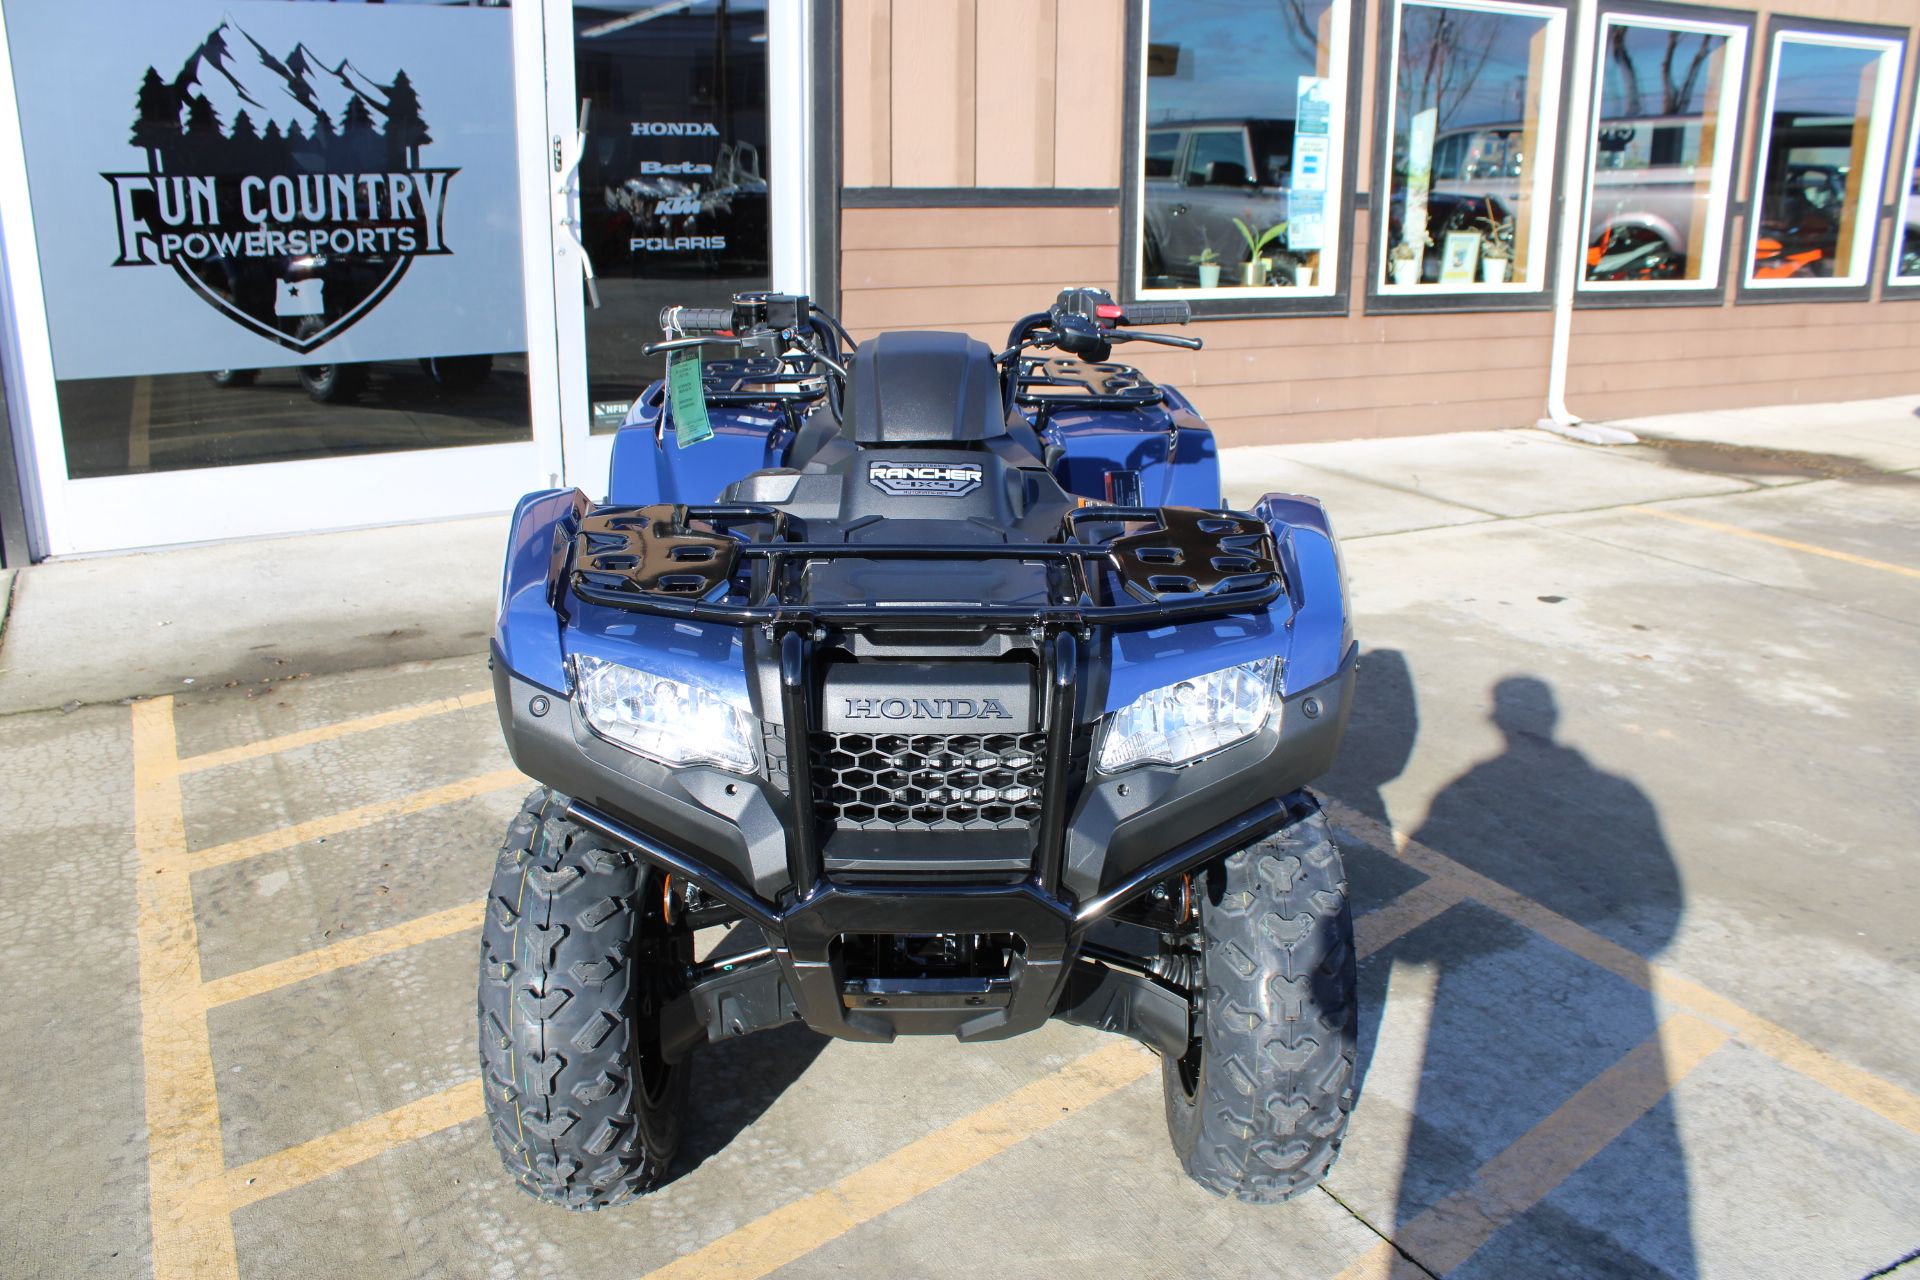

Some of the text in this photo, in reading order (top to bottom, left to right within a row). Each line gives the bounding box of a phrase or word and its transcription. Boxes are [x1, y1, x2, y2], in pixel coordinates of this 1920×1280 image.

[631, 122, 719, 136] HONDA
[640, 161, 713, 174] Beta
[655, 197, 701, 215] KTM
[114, 172, 448, 262] FUN COUNTRY
[161, 226, 417, 260] POWERSPORTS
[630, 236, 726, 251] POLARIS
[606, 404, 628, 414] NFIB
[869, 468, 982, 482] RANCHER
[845, 698, 1013, 719] HONDA
